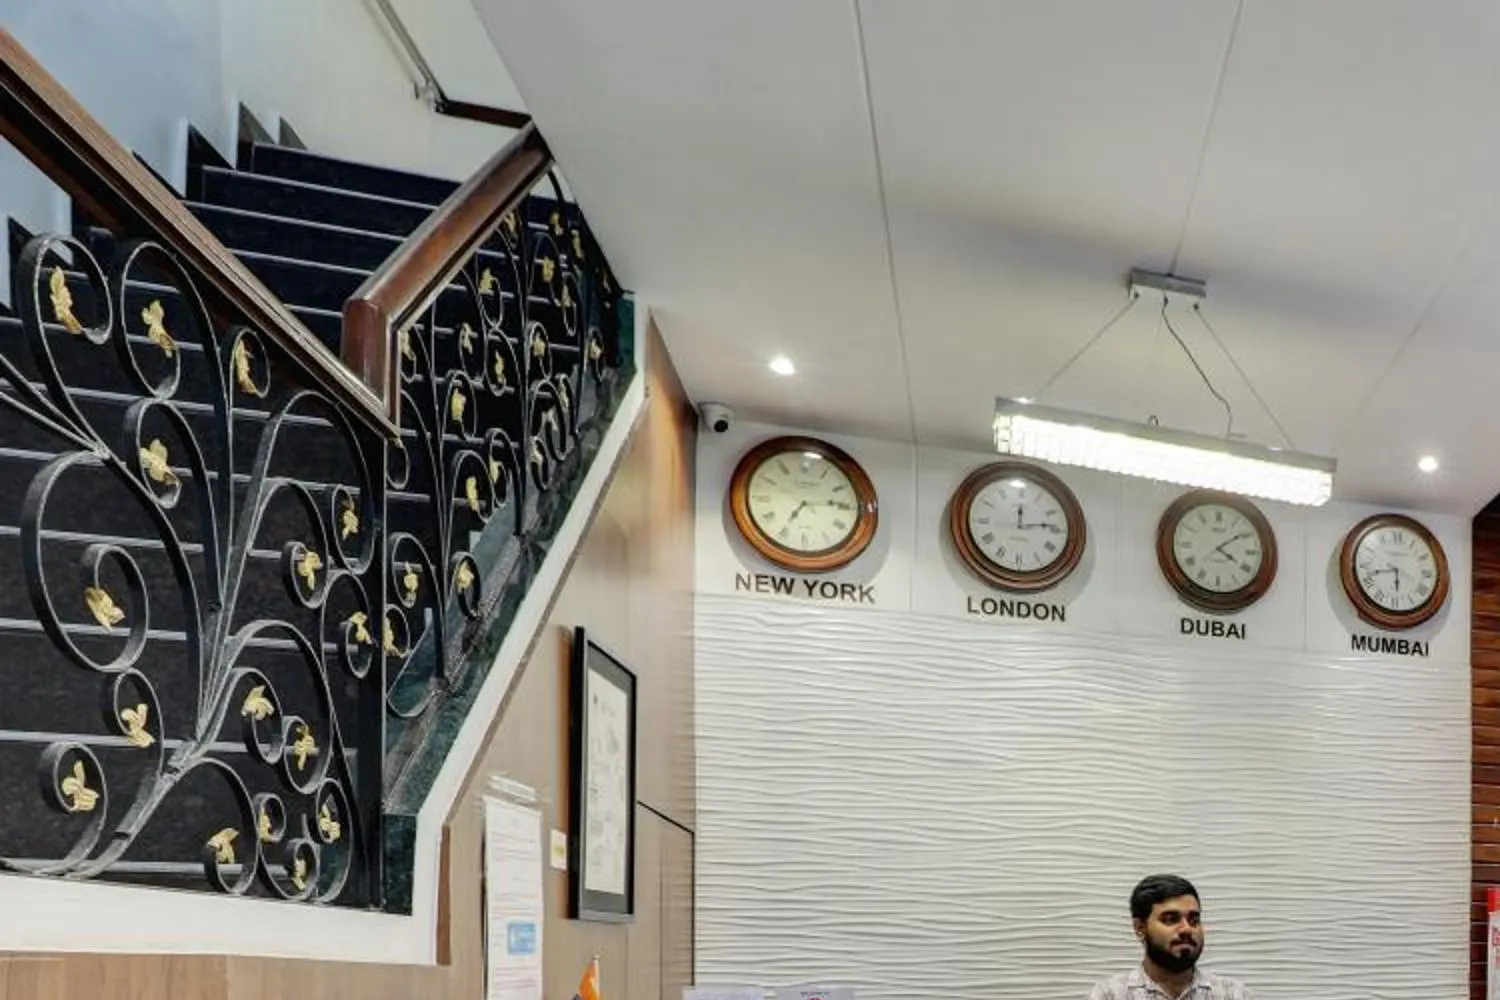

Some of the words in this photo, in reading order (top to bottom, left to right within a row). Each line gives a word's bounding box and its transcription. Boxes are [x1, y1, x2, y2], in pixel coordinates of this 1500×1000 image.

[735, 572, 795, 595] NEW
[803, 579, 876, 604] YORK
[966, 596, 1067, 622] LONDON
[1180, 617, 1247, 641] DUBAI
[1351, 634, 1430, 658] MUMBAI
